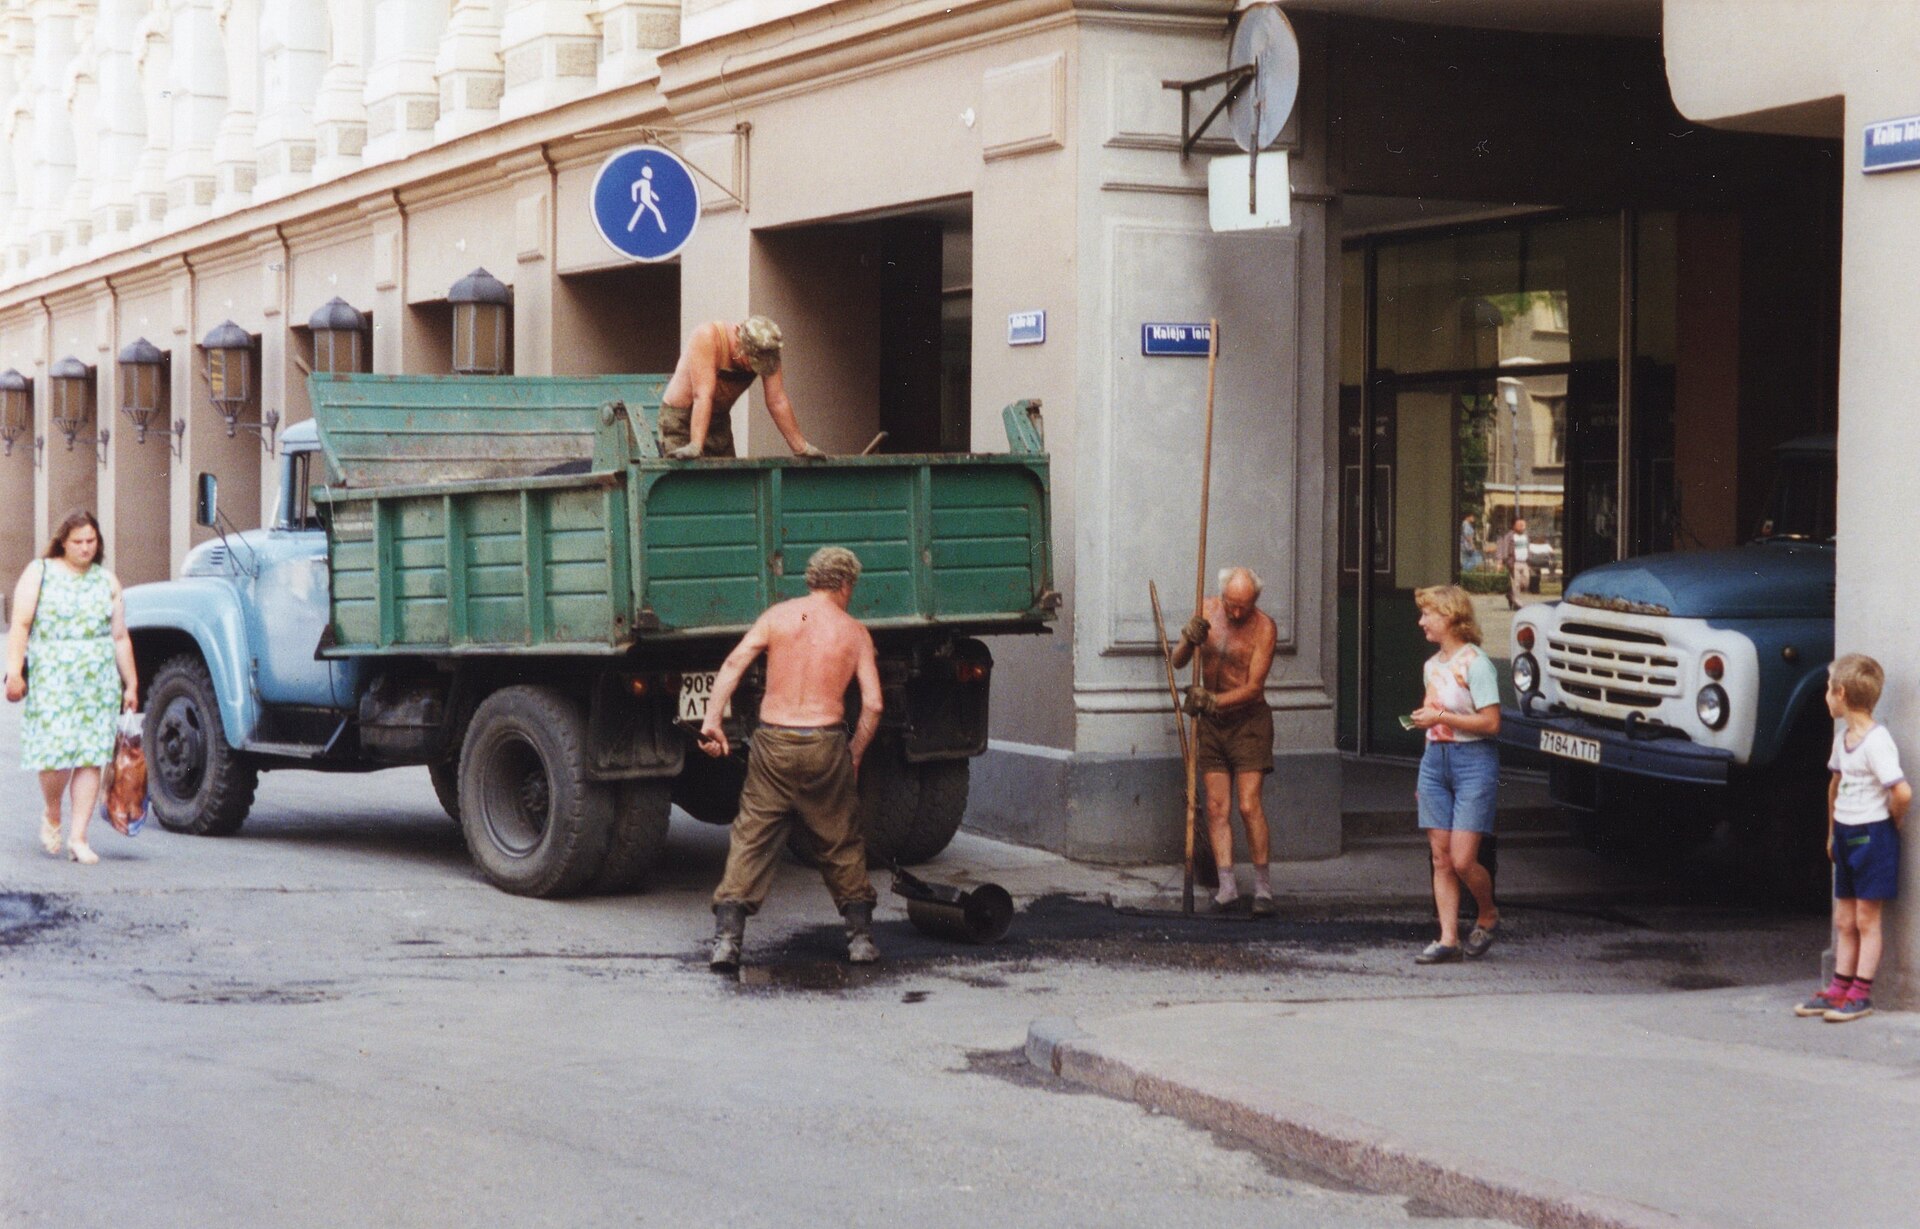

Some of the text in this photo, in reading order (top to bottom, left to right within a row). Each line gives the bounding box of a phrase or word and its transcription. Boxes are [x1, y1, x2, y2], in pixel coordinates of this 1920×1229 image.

[684, 675, 715, 695] 908
[686, 697, 710, 716] ЛТ
[1543, 732, 1568, 754] 7184
